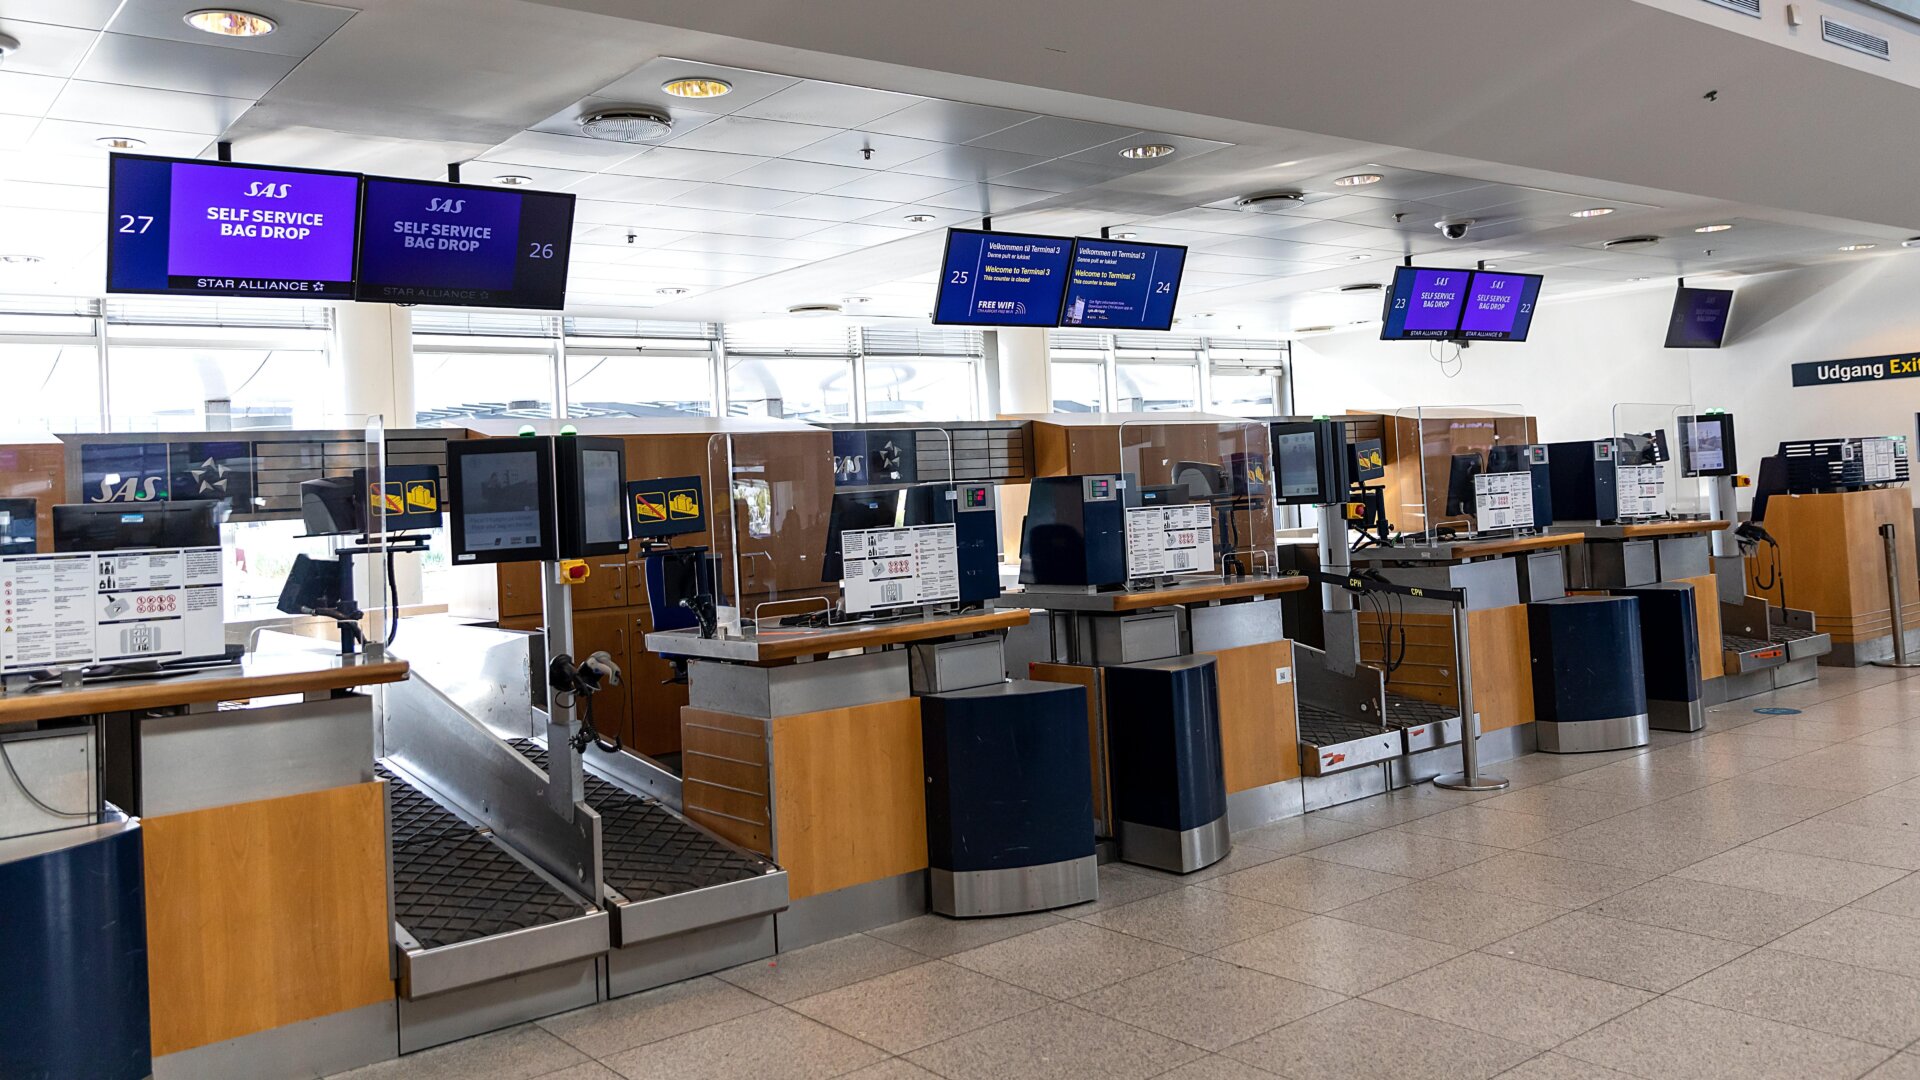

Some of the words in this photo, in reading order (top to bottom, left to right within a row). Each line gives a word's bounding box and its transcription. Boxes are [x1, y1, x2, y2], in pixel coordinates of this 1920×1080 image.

[244, 181, 292, 199] SAS
[426, 197, 466, 214] SAS
[207, 206, 249, 221] SELF
[252, 209, 324, 226] SERVICE
[119, 214, 154, 234] 27
[393, 221, 430, 235] SELF
[431, 223, 492, 239] SERVICE
[220, 223, 257, 238] BAG
[261, 226, 311, 240] DROP
[404, 236, 435, 249] BAG
[438, 239, 480, 252] DROP
[989, 242, 1023, 251] Velkommen
[1031, 245, 1056, 254] Terminal
[529, 242, 554, 259] 26
[1080, 248, 1110, 257] Velkommen
[1118, 251, 1141, 259] Terminal
[985, 265, 1012, 274] Welcome
[1075, 269, 1100, 278] Welcome
[1108, 272, 1131, 280] Terminal
[951, 270, 969, 284] 25
[1434, 277, 1450, 286] SAS
[197, 278, 235, 289] STAR
[239, 280, 309, 291] ALLIANCE
[1156, 281, 1171, 294] 24
[1490, 280, 1506, 289] SAS
[383, 286, 415, 297] STAR
[418, 288, 476, 299] ALLIANCE
[1434, 292, 1456, 300] SERVICE
[1491, 294, 1512, 303] SERVICE
[978, 300, 996, 309] FREE
[997, 301, 1015, 309] WIFI
[1394, 298, 1406, 309] 23
[1423, 300, 1434, 308] BAG
[1520, 303, 1531, 313] 22
[1817, 363, 1884, 381] Udgang
[91, 476, 162, 503] SAS
[1349, 578, 1362, 588] CPH
[1410, 588, 1423, 597] CPH
